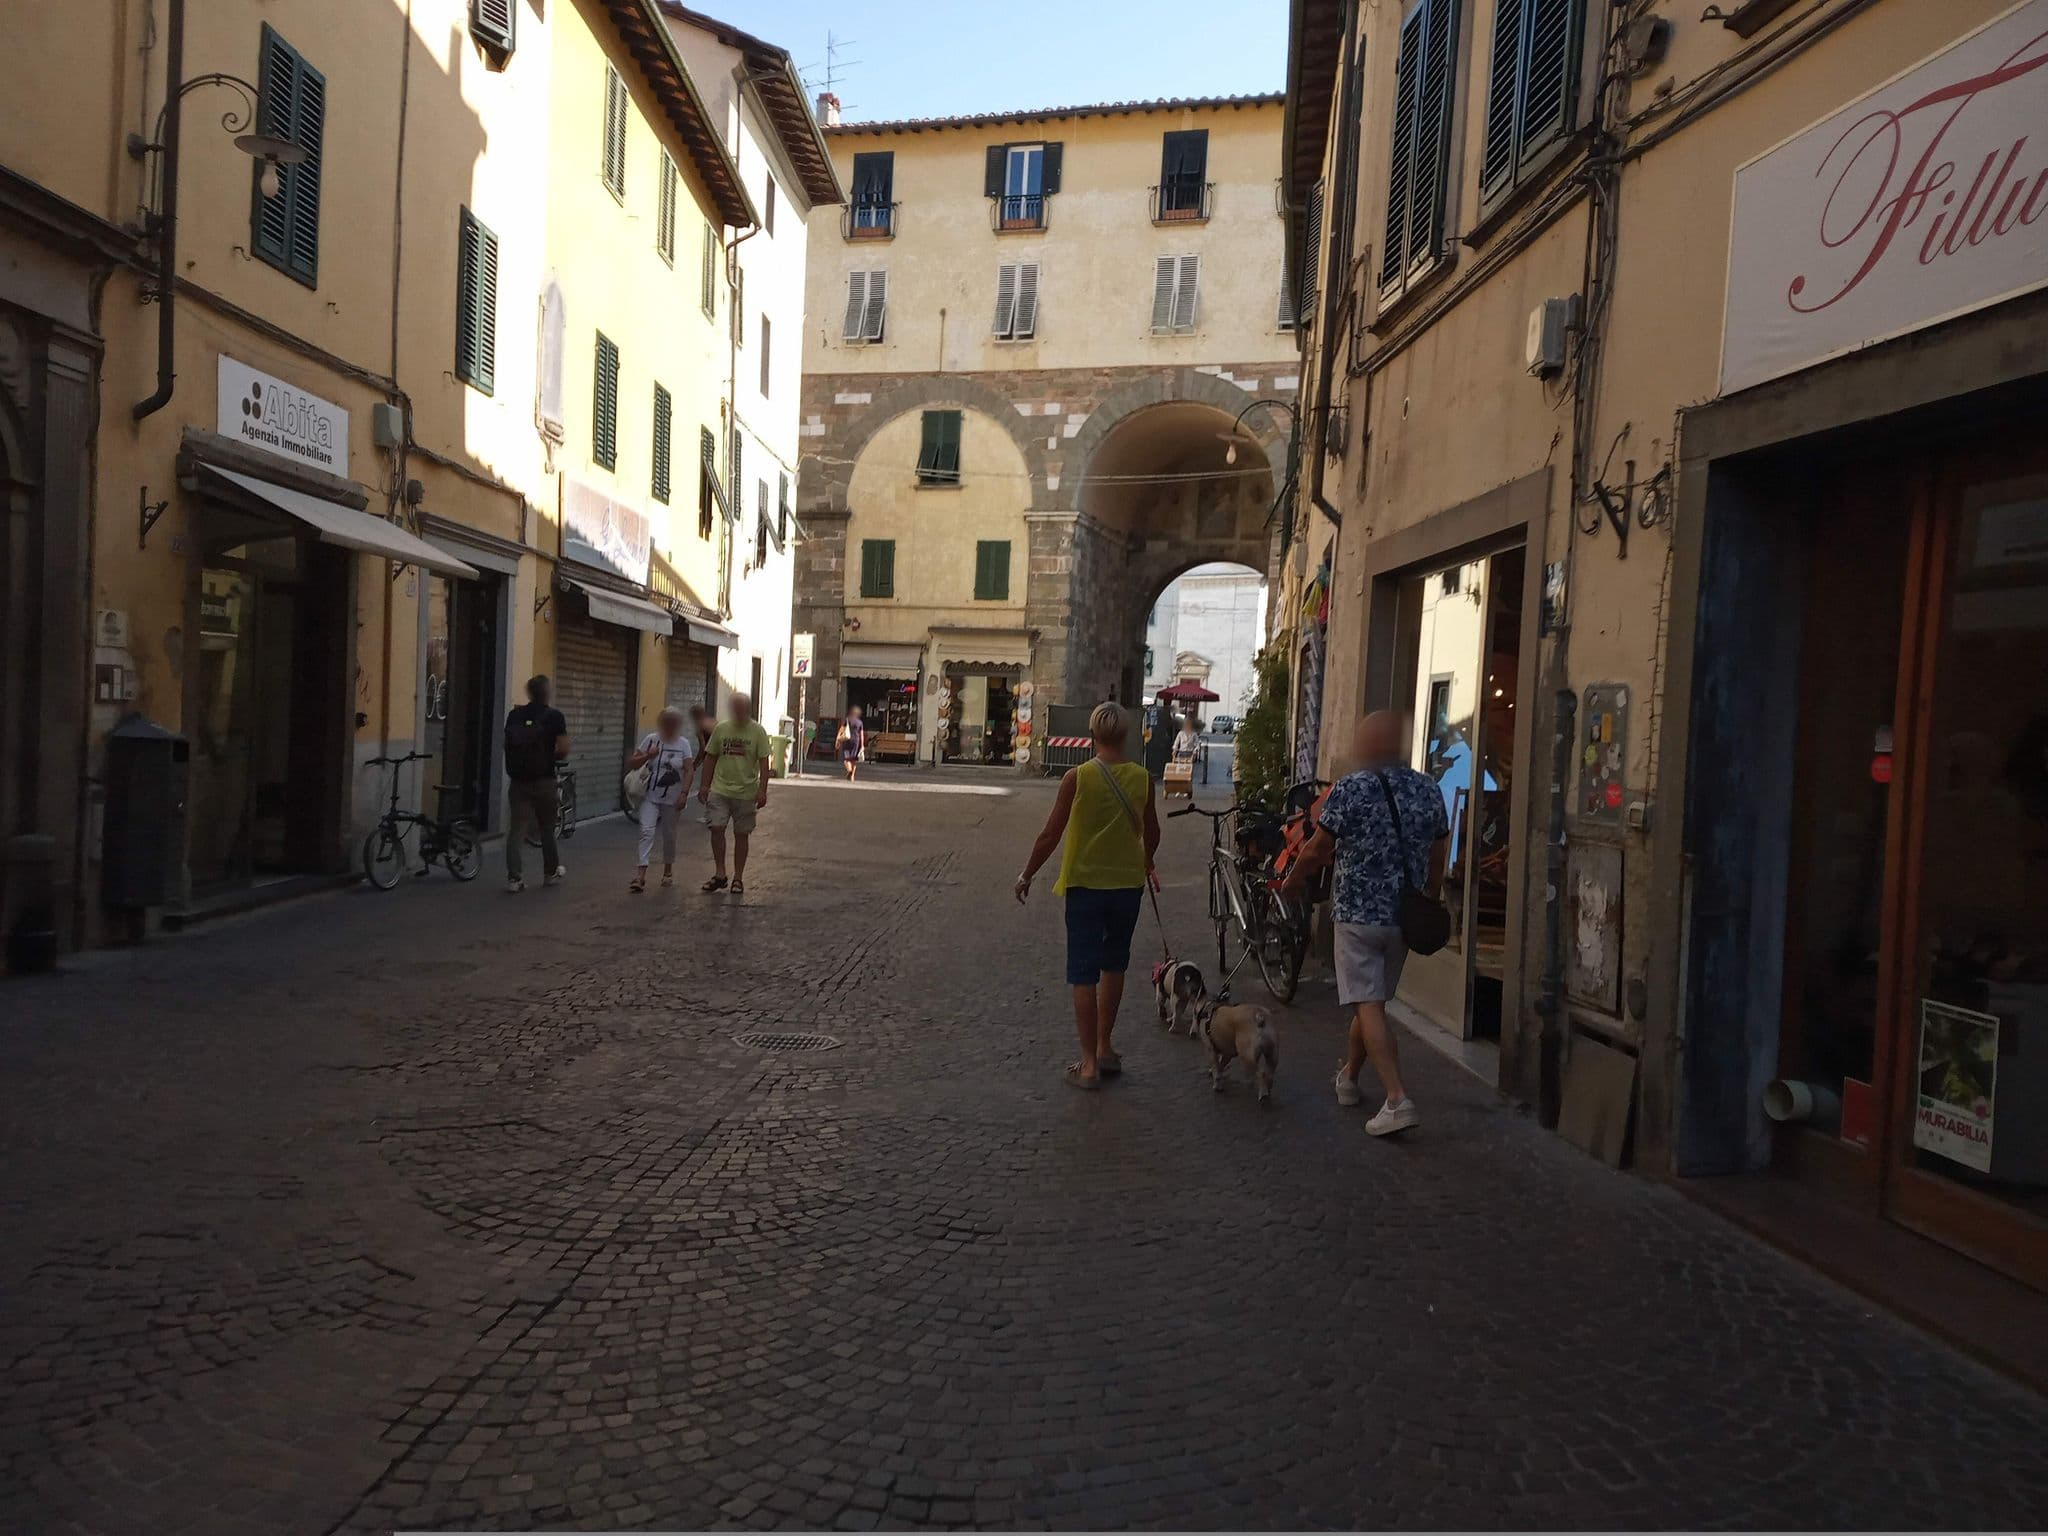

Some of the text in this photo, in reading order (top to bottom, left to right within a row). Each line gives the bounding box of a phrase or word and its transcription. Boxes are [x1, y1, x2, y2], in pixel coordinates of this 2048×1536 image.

[262, 384, 332, 449] Abita
[241, 420, 333, 465] Agenzia Immobiliare
[1918, 1109, 1989, 1146] MURABILIA
